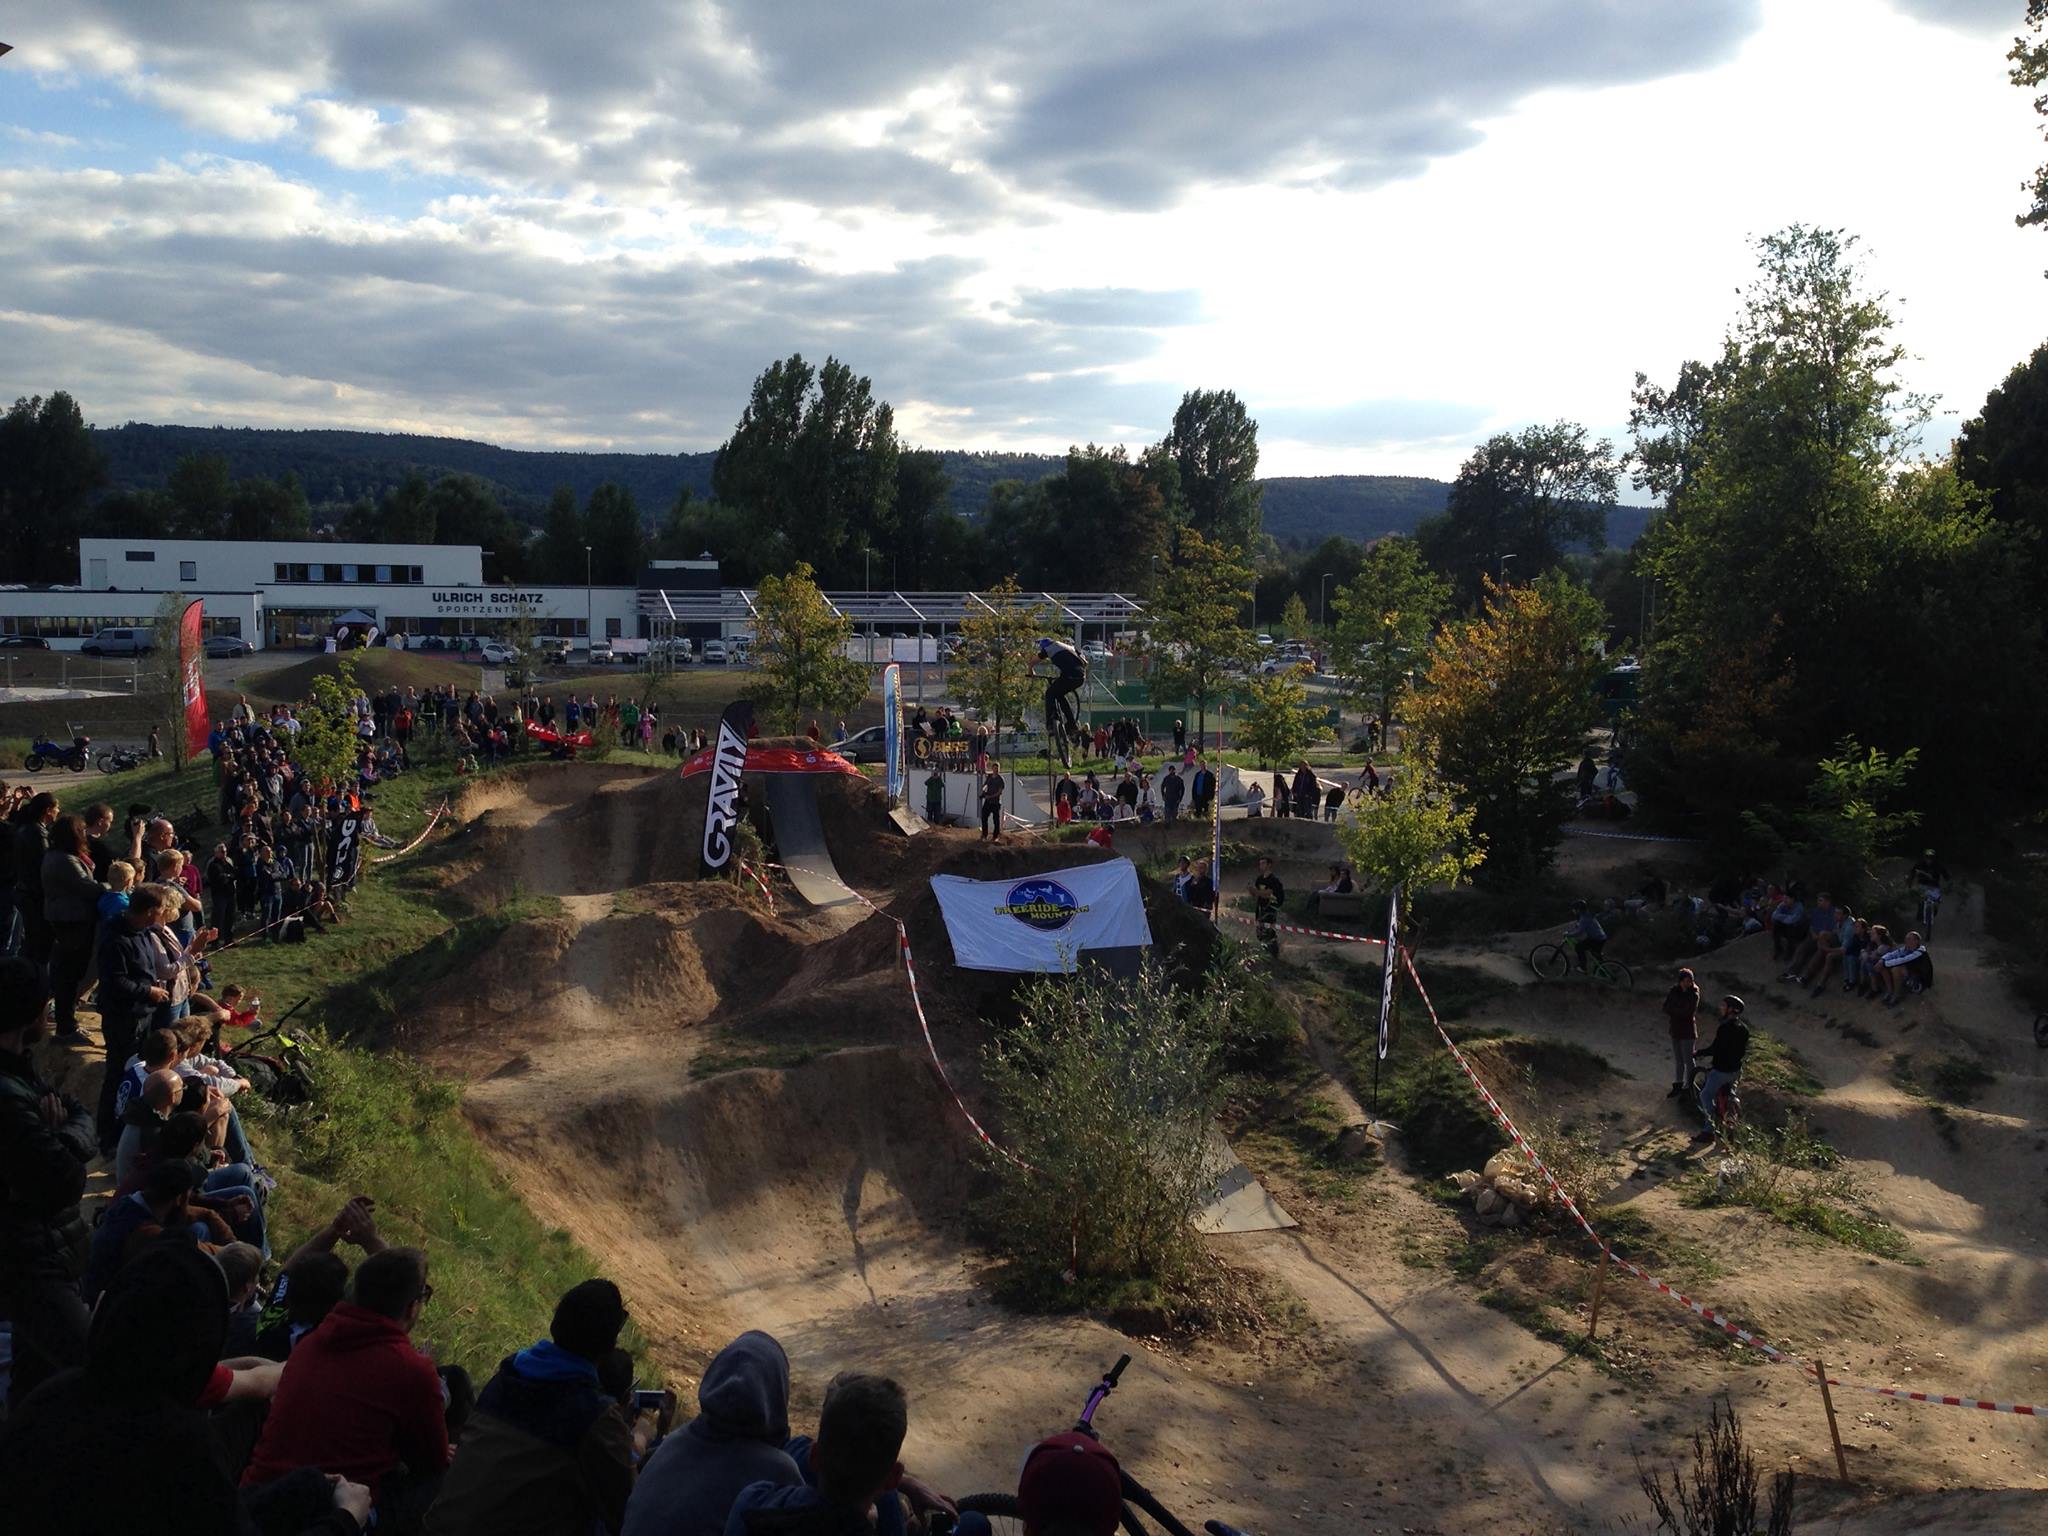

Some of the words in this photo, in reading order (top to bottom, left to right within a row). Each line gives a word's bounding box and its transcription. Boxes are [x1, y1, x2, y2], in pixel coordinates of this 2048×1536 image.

[432, 592, 483, 603] ULRICH
[490, 593, 544, 604] SCHATZ
[437, 605, 537, 614] SPORTZENTRUM
[703, 721, 748, 868] GRAVITY
[994, 903, 1060, 916] FREERIDE
[1030, 905, 1090, 919] MOUNTAIN
